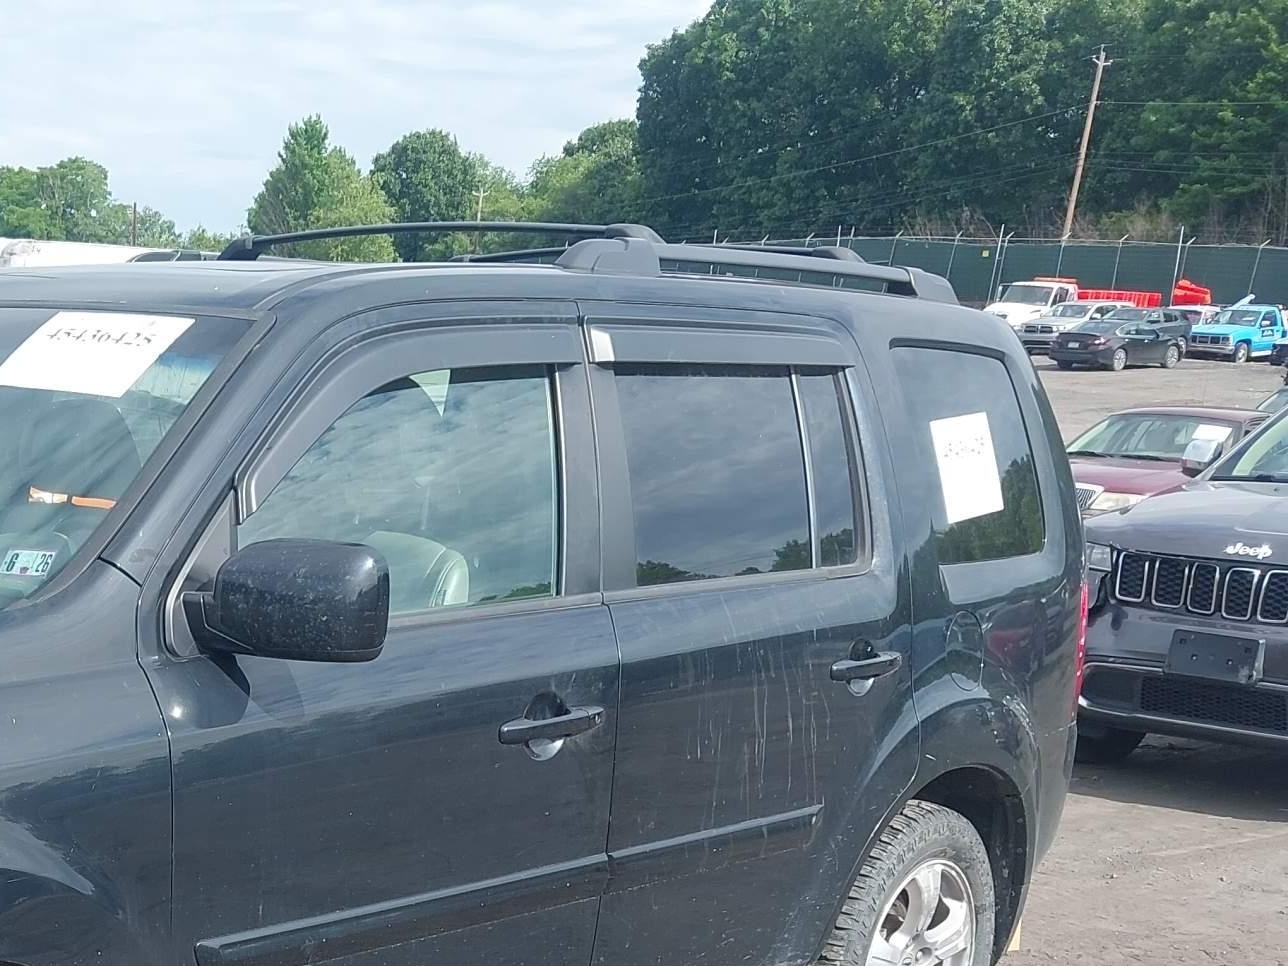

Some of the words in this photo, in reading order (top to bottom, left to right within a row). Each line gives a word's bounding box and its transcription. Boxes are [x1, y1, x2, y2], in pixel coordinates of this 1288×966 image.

[1223, 542, 1272, 560] Jeep
[6, 552, 19, 572] 6
[35, 553, 53, 573] 26
